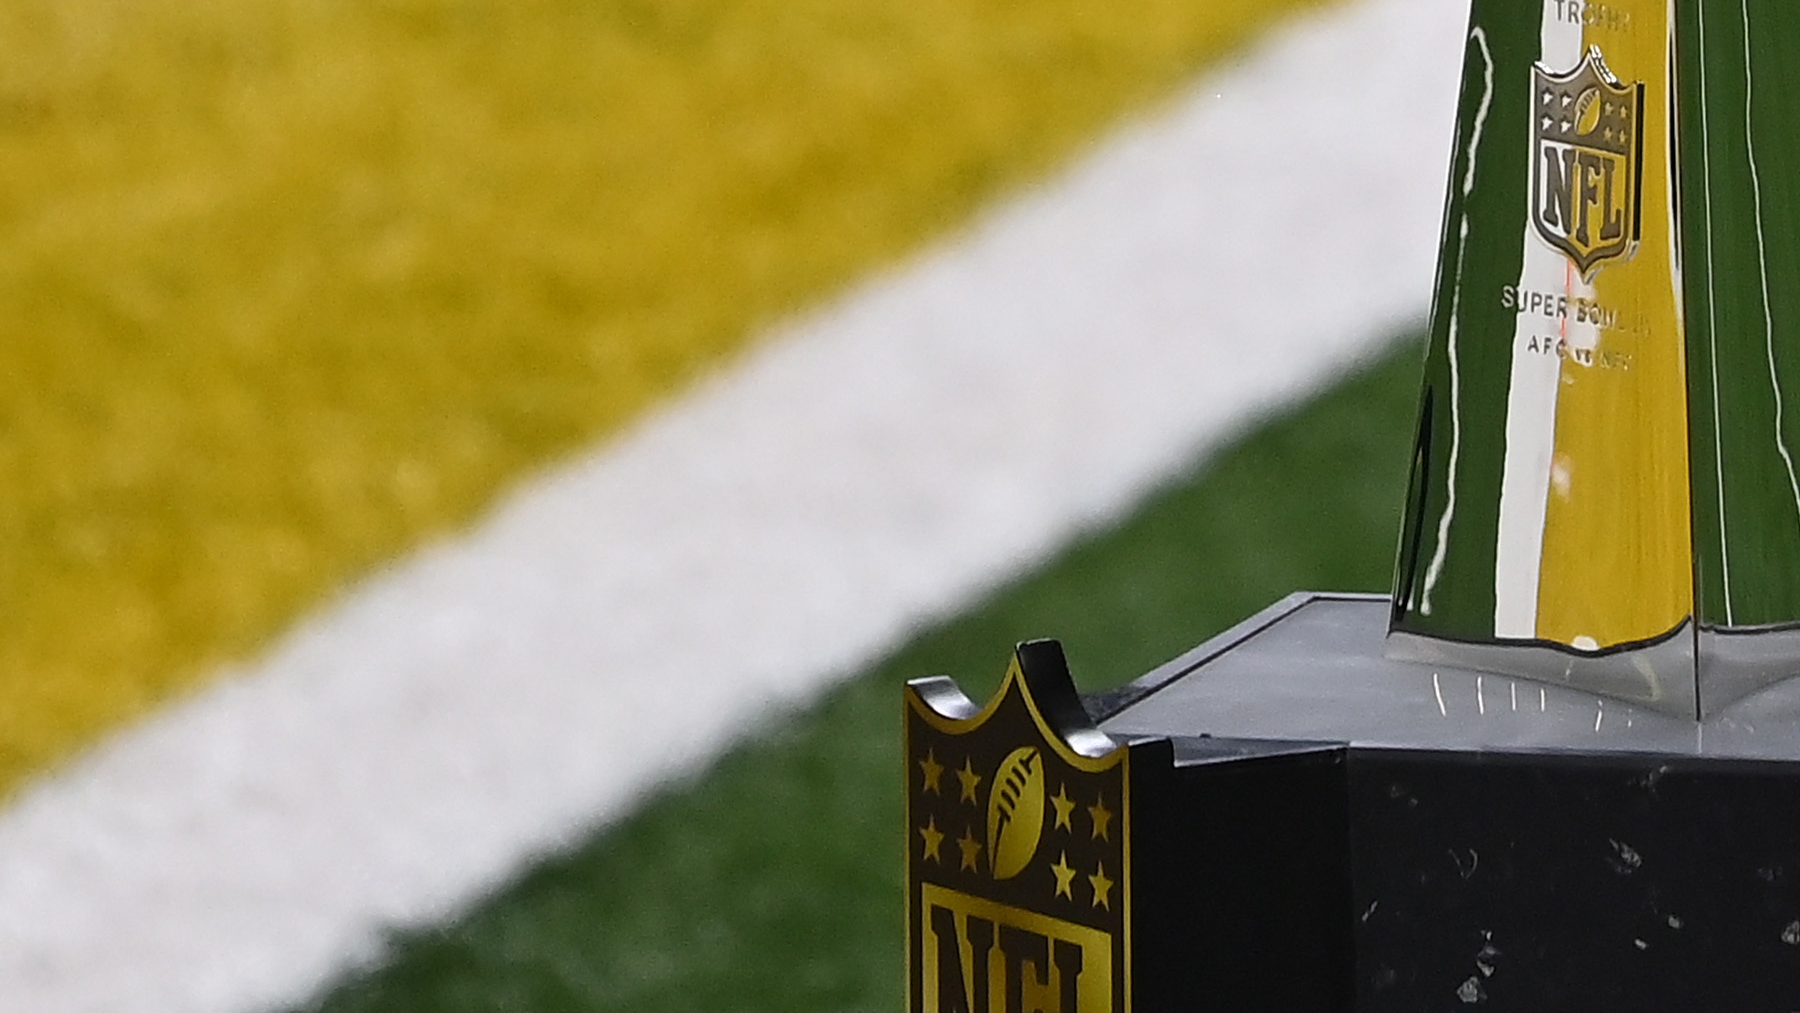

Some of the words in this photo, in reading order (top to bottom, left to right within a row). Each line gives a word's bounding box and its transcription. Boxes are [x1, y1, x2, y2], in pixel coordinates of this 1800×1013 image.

[1543, 145, 1622, 248] NFL
[1501, 285, 1568, 318] SUPER
[1527, 335, 1567, 361] AFC
